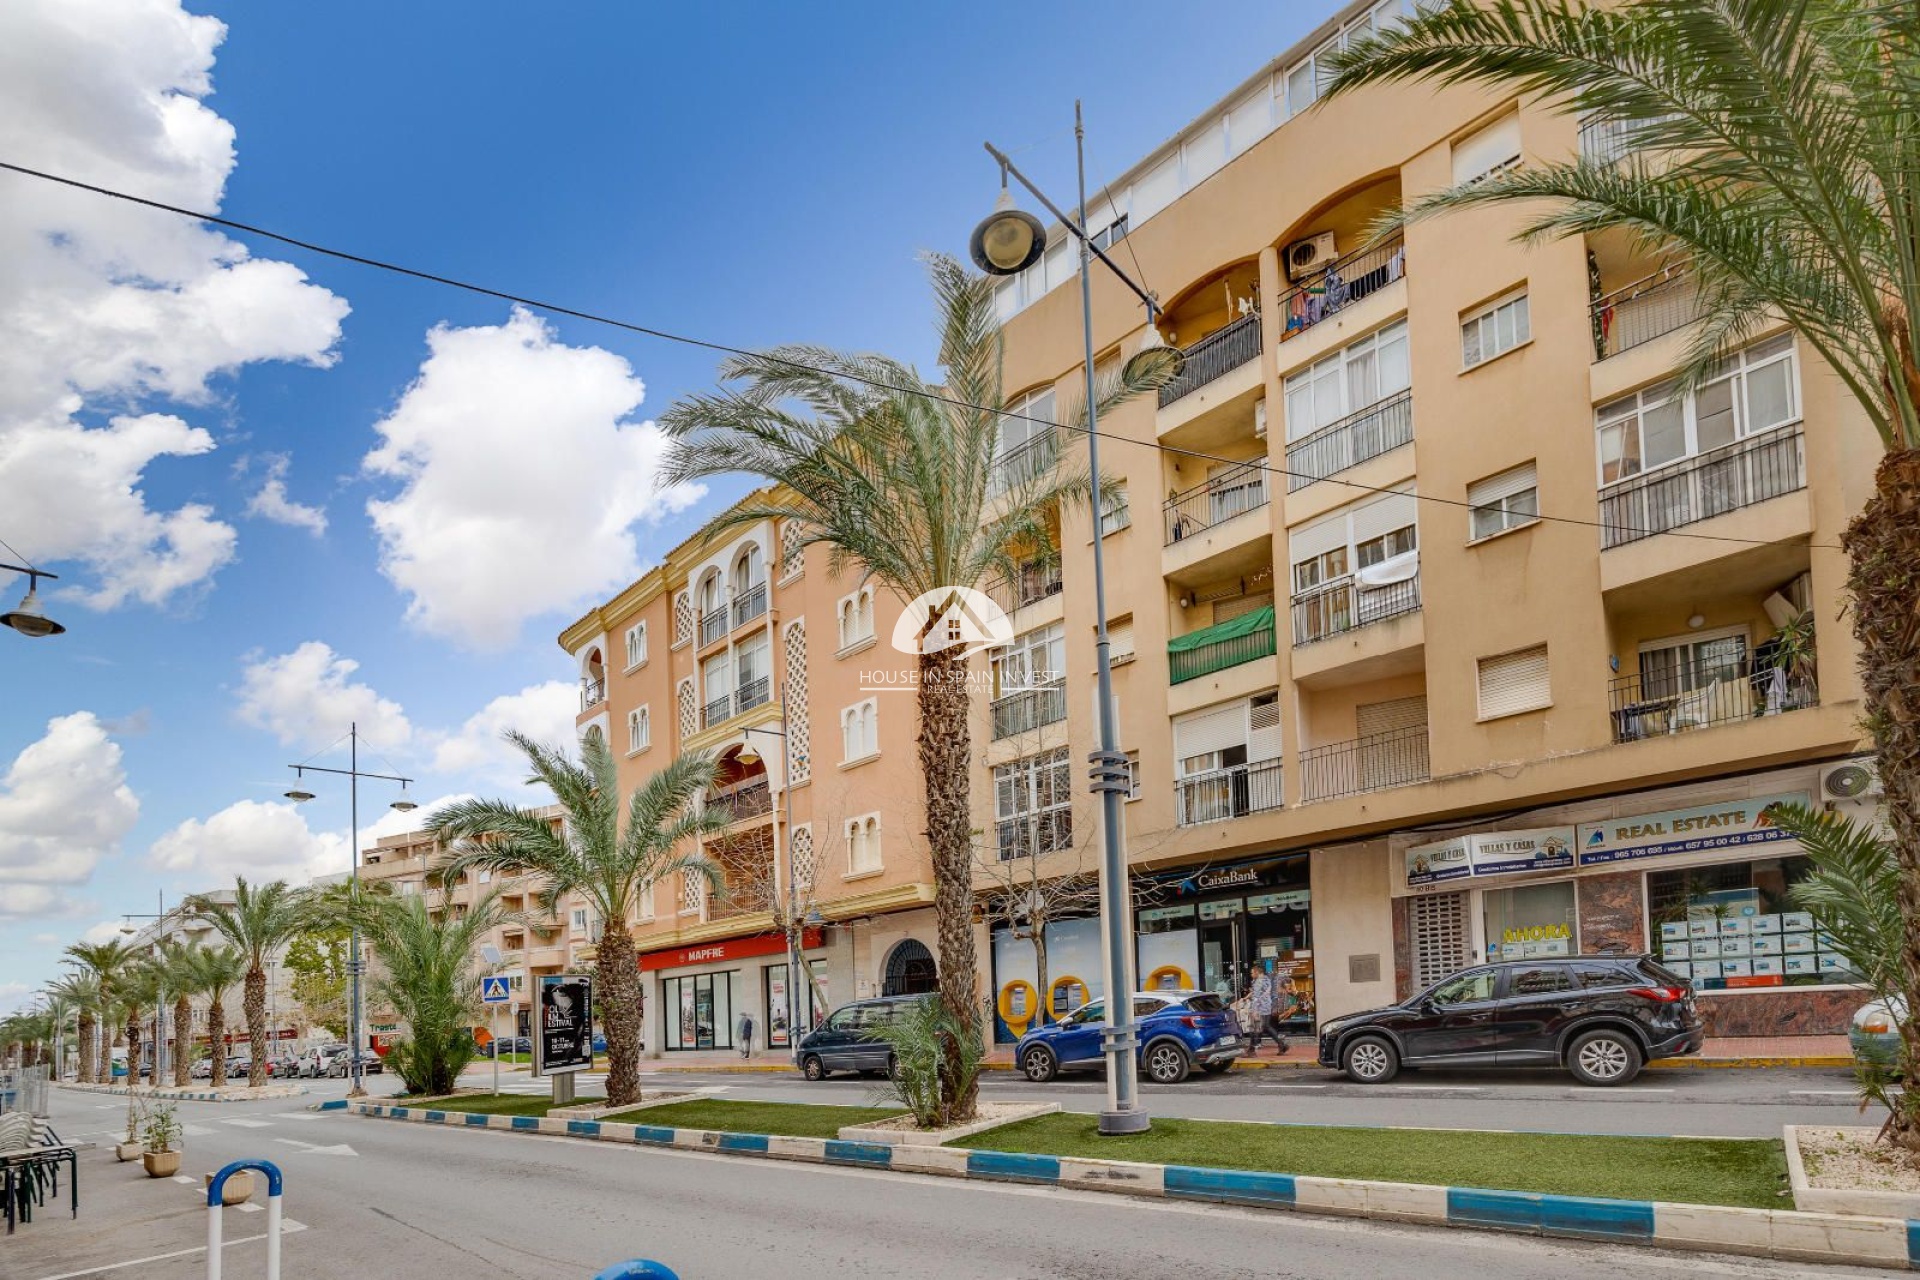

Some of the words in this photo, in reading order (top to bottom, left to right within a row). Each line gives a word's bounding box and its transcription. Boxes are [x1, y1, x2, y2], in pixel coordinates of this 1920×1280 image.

[1615, 822, 1667, 840] REAL
[1672, 810, 1746, 834] ESTATE
[1479, 843, 1504, 854] VILLAS
[1505, 842, 1512, 851] Y
[1513, 840, 1536, 850] CASAS
[1686, 840, 1701, 849] 657
[1703, 839, 1714, 847] 95
[1729, 836, 1741, 844] 42
[1746, 833, 1764, 842] 628
[1198, 868, 1258, 887] CaixaBank
[1503, 923, 1572, 943] AHORA
[688, 946, 725, 961] MAPFRE
